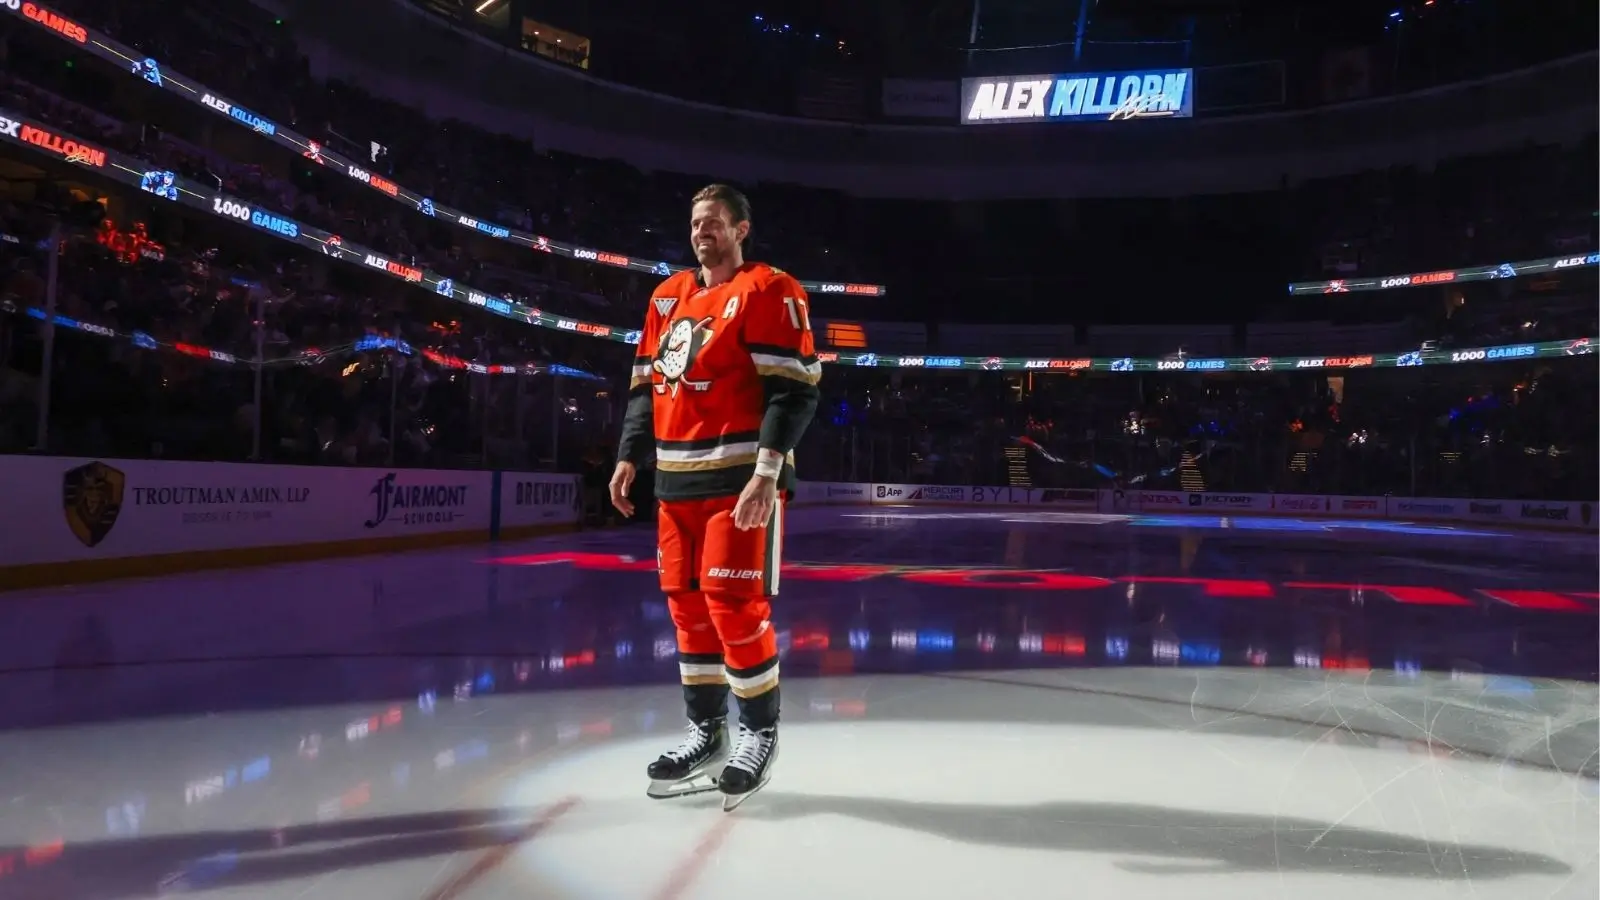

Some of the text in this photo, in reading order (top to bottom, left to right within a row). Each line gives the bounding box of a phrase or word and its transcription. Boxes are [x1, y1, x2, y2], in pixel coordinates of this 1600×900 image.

[22, 3, 88, 43] GAMES
[968, 80, 1052, 120] ALEX
[1050, 72, 1188, 118] KILLORN
[201, 94, 276, 135] ALEX KILLORN
[0, 116, 106, 167] EX KILLORN
[348, 165, 398, 196] 1,000 GAMES
[213, 198, 298, 238] 1,000 GAMES
[458, 215, 478, 229] ALEX
[364, 254, 388, 271] ALEX
[574, 248, 629, 267] 1,000 GAMES
[1554, 257, 1587, 269] ALEX
[1381, 271, 1454, 288] 1,000 GAMES
[846, 286, 879, 295] GAMES
[467, 292, 511, 314] 1,000 GAMES
[722, 296, 739, 319] A
[557, 319, 578, 330] ALEX
[924, 358, 961, 367] GAMES
[1452, 345, 1535, 362] 1,000 GAMES
[1025, 360, 1050, 369] ALEX
[1185, 359, 1225, 369] GAMES
[1297, 359, 1324, 367] ALEX
[132, 486, 236, 506] TROUTMAN
[287, 487, 310, 502] LLP
[364, 473, 469, 529] FAIRMONT
